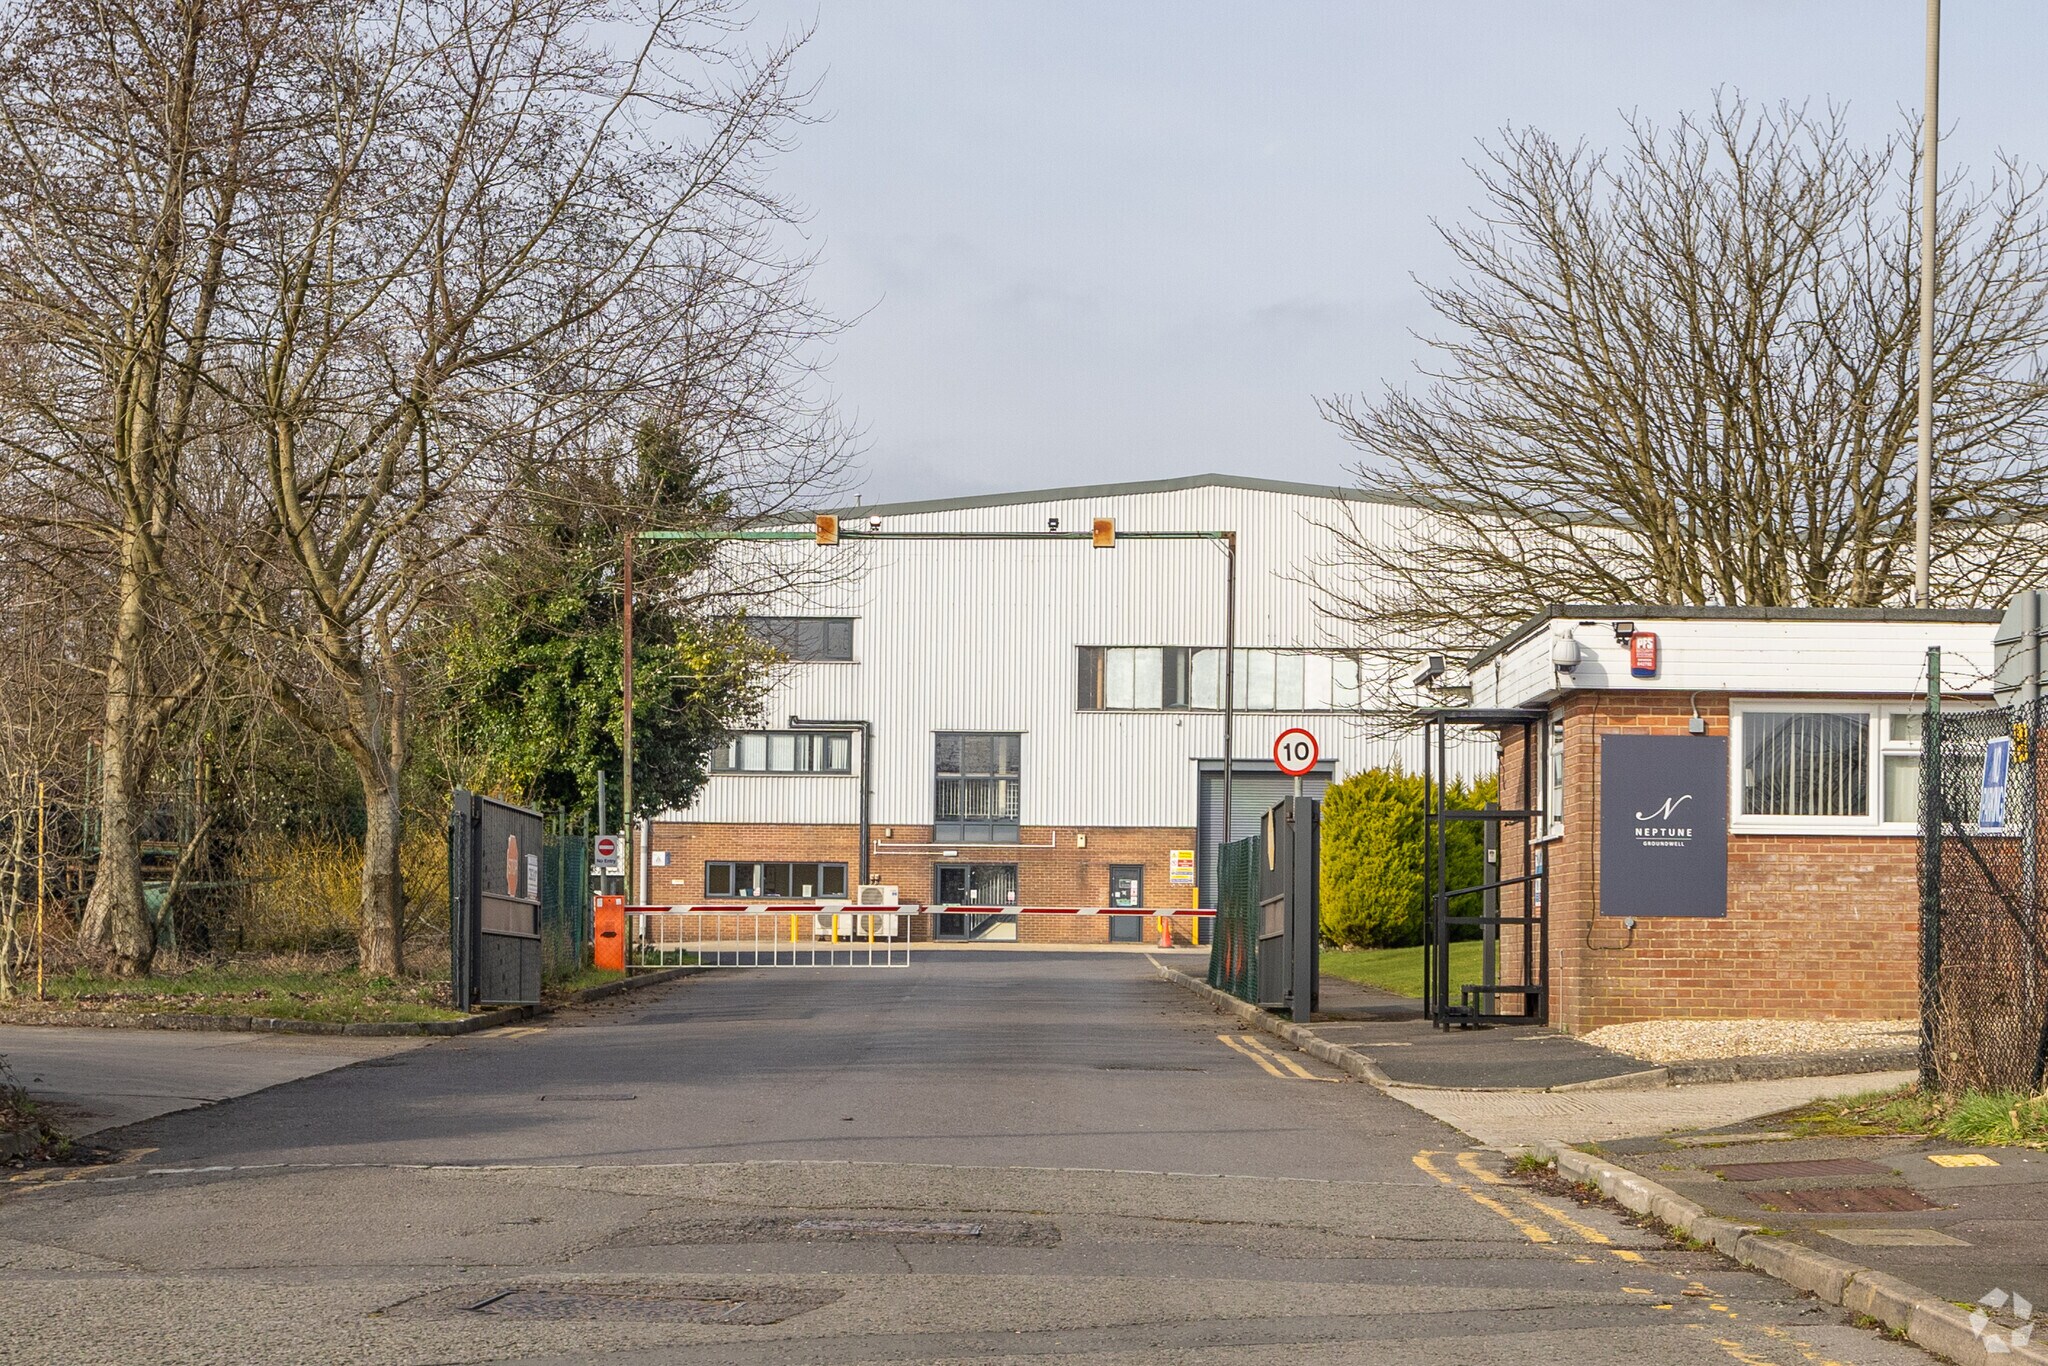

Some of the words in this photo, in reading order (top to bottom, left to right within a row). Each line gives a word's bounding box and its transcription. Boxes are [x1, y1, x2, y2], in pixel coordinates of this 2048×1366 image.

[1637, 637, 1653, 649] PFS
[1283, 741, 1309, 761] 10
[1635, 827, 1692, 837] NEPTUNE
